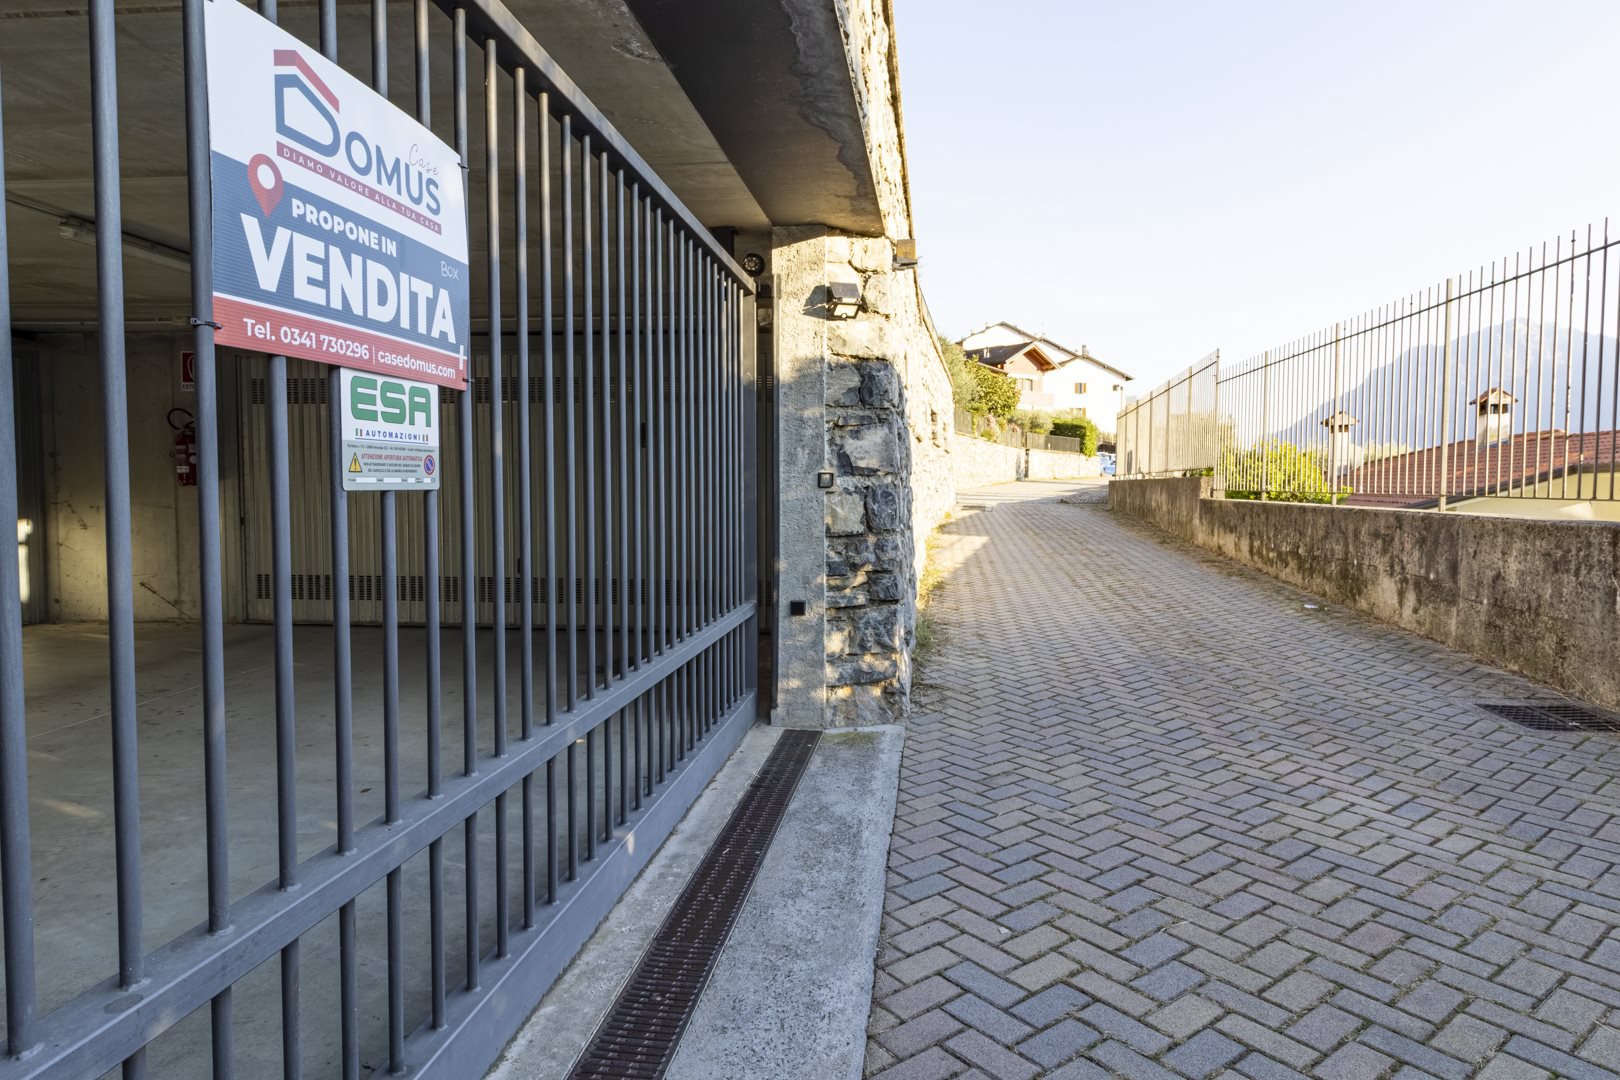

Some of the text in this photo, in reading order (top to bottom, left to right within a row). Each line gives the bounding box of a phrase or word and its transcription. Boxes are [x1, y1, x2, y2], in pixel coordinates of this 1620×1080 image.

[274, 74, 441, 216] DOMUS
[409, 143, 439, 176] Case
[283, 148, 439, 231] DIAMO VALORE ALLA TUA CASA
[291, 198, 397, 258] PROPONE IN
[240, 212, 457, 344] VENDITA
[243, 318, 456, 379] Tel. 0341 730296 casedomus.com
[350, 375, 432, 428] ESA
[365, 430, 421, 441] AUTOMAZIONI
